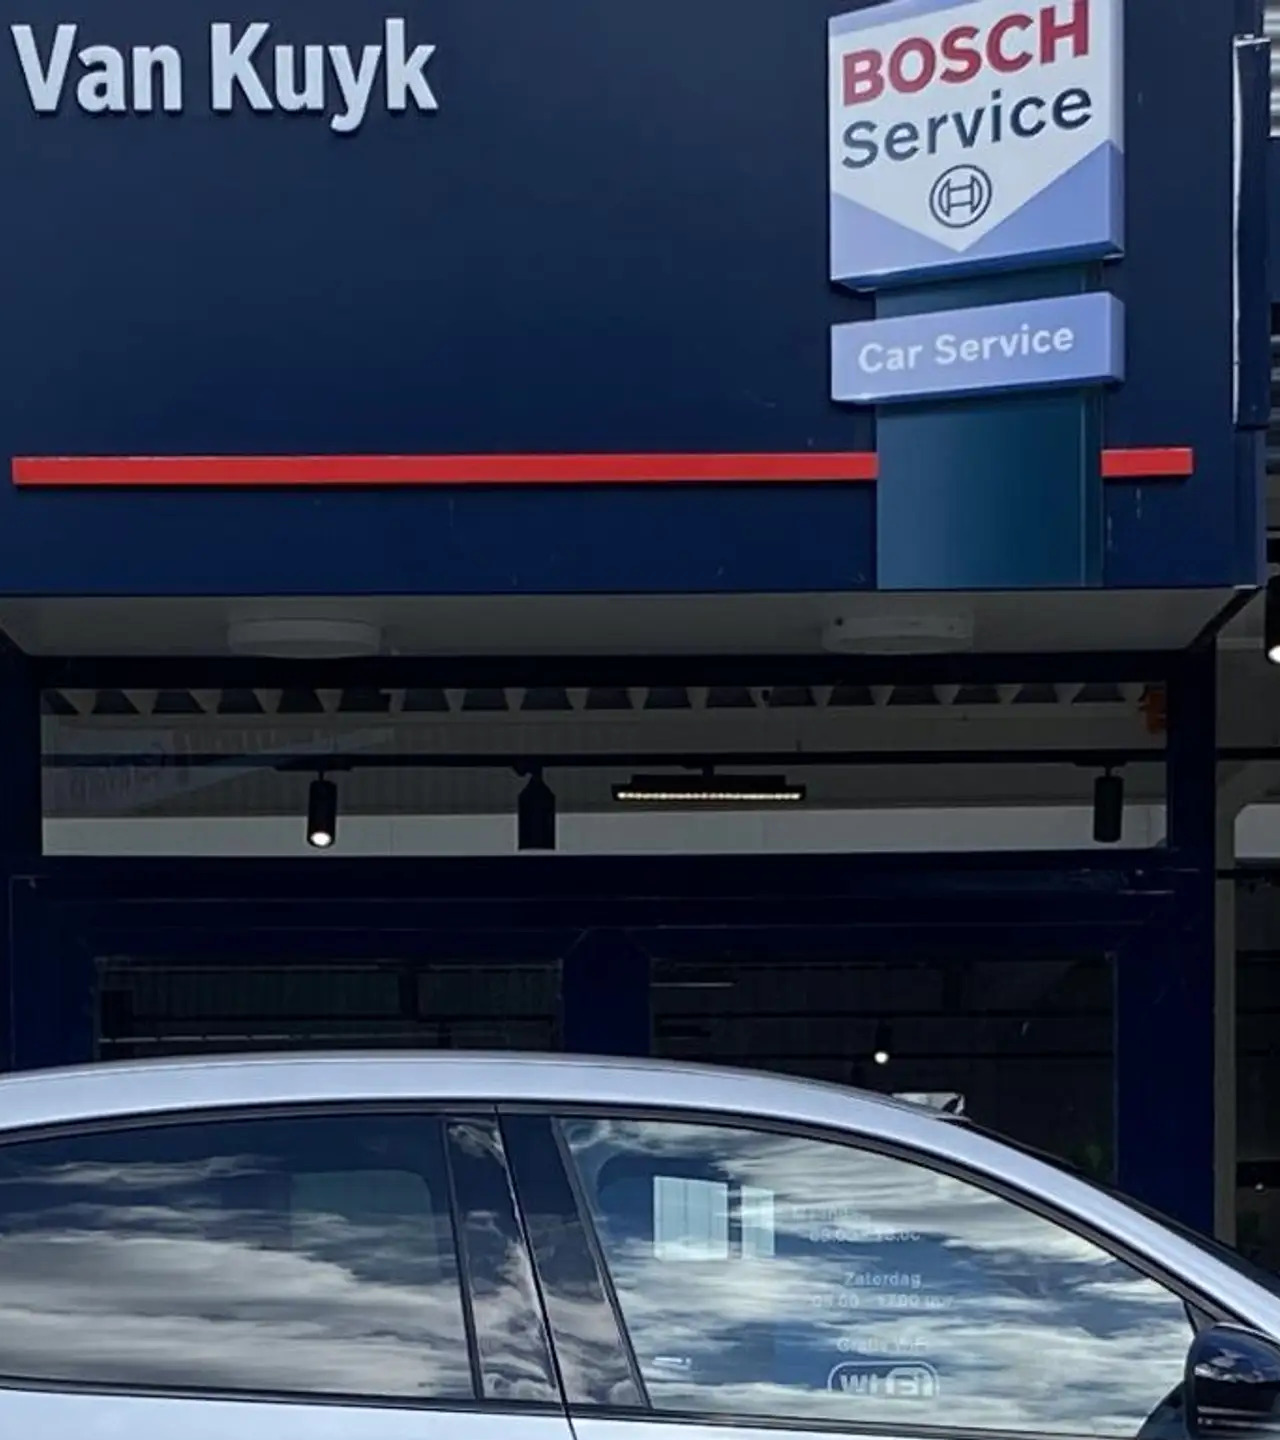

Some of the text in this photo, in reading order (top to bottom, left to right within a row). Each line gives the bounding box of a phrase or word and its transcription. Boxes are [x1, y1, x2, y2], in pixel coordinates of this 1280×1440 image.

[11, 17, 439, 132] Van Kuyk
[842, 0, 1090, 107] BOSCH
[841, 87, 1092, 169] Service
[857, 322, 1075, 374] Car Service
